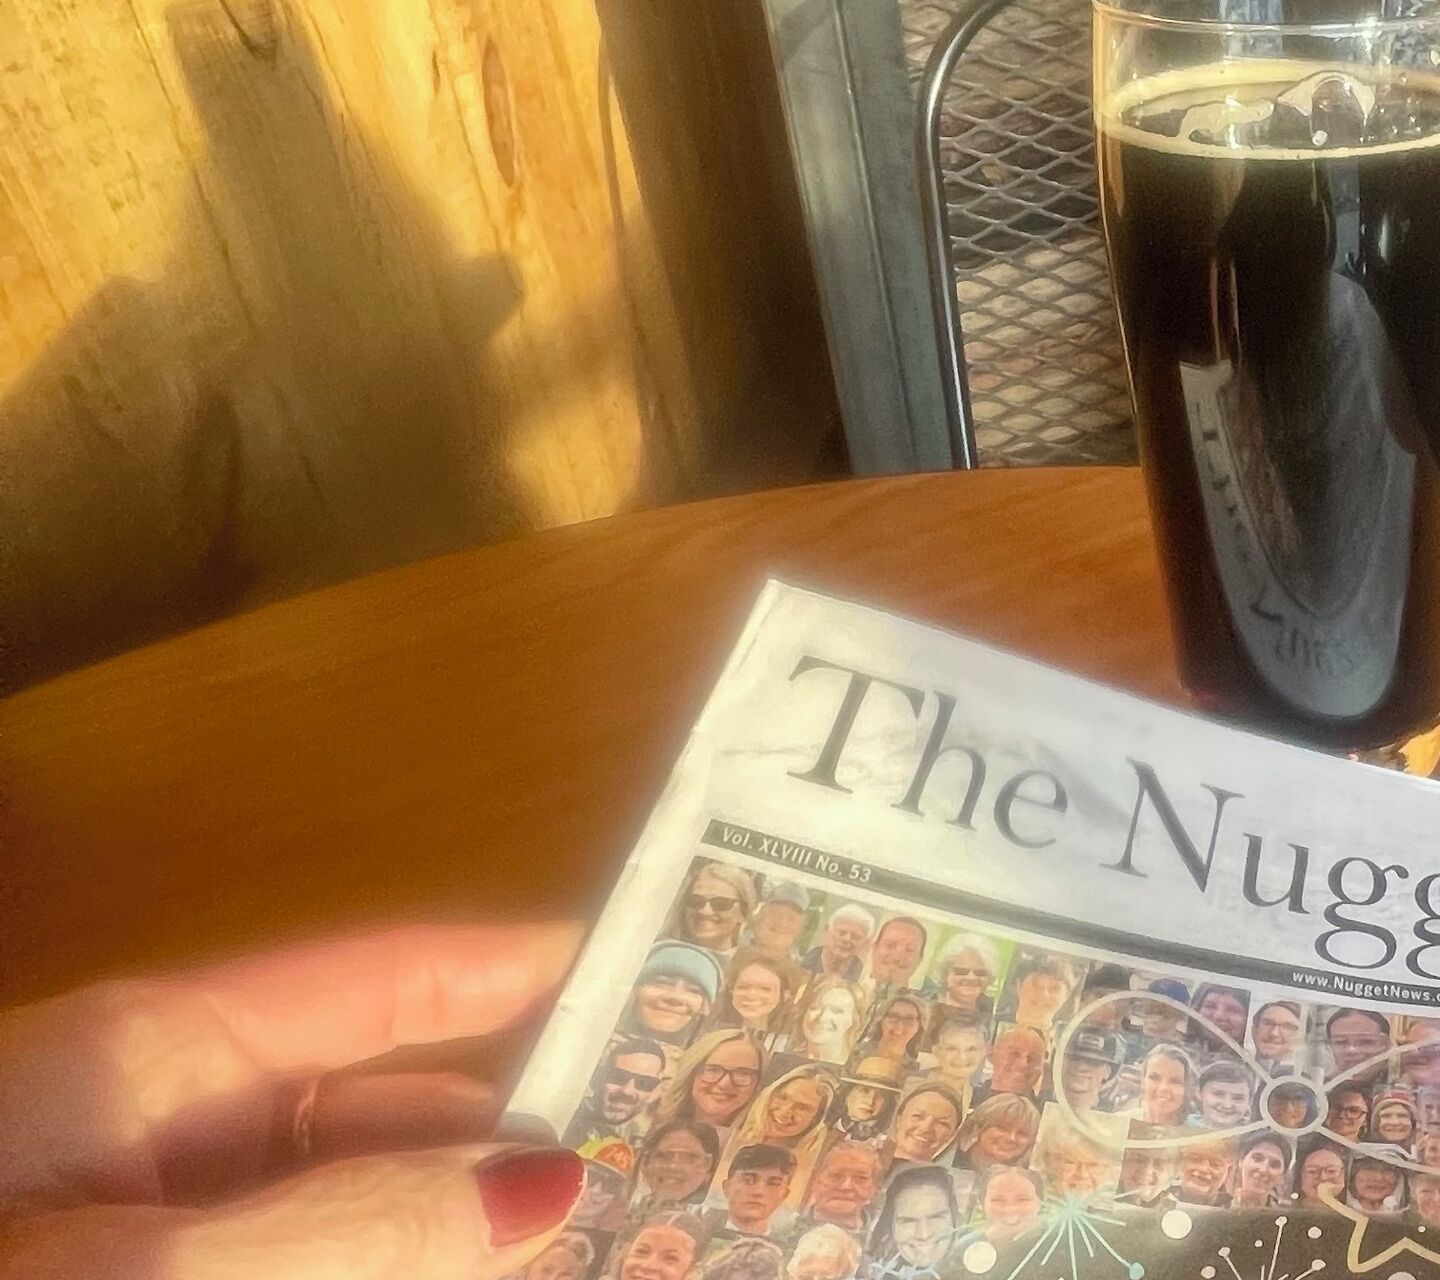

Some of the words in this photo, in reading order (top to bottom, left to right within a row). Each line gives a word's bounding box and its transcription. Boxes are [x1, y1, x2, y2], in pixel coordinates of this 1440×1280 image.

[786, 656, 1067, 849] The
[722, 827, 752, 849] Vol.
[759, 838, 812, 865] XLVIII
[815, 853, 842, 876] No.
[849, 864, 872, 882] 53
